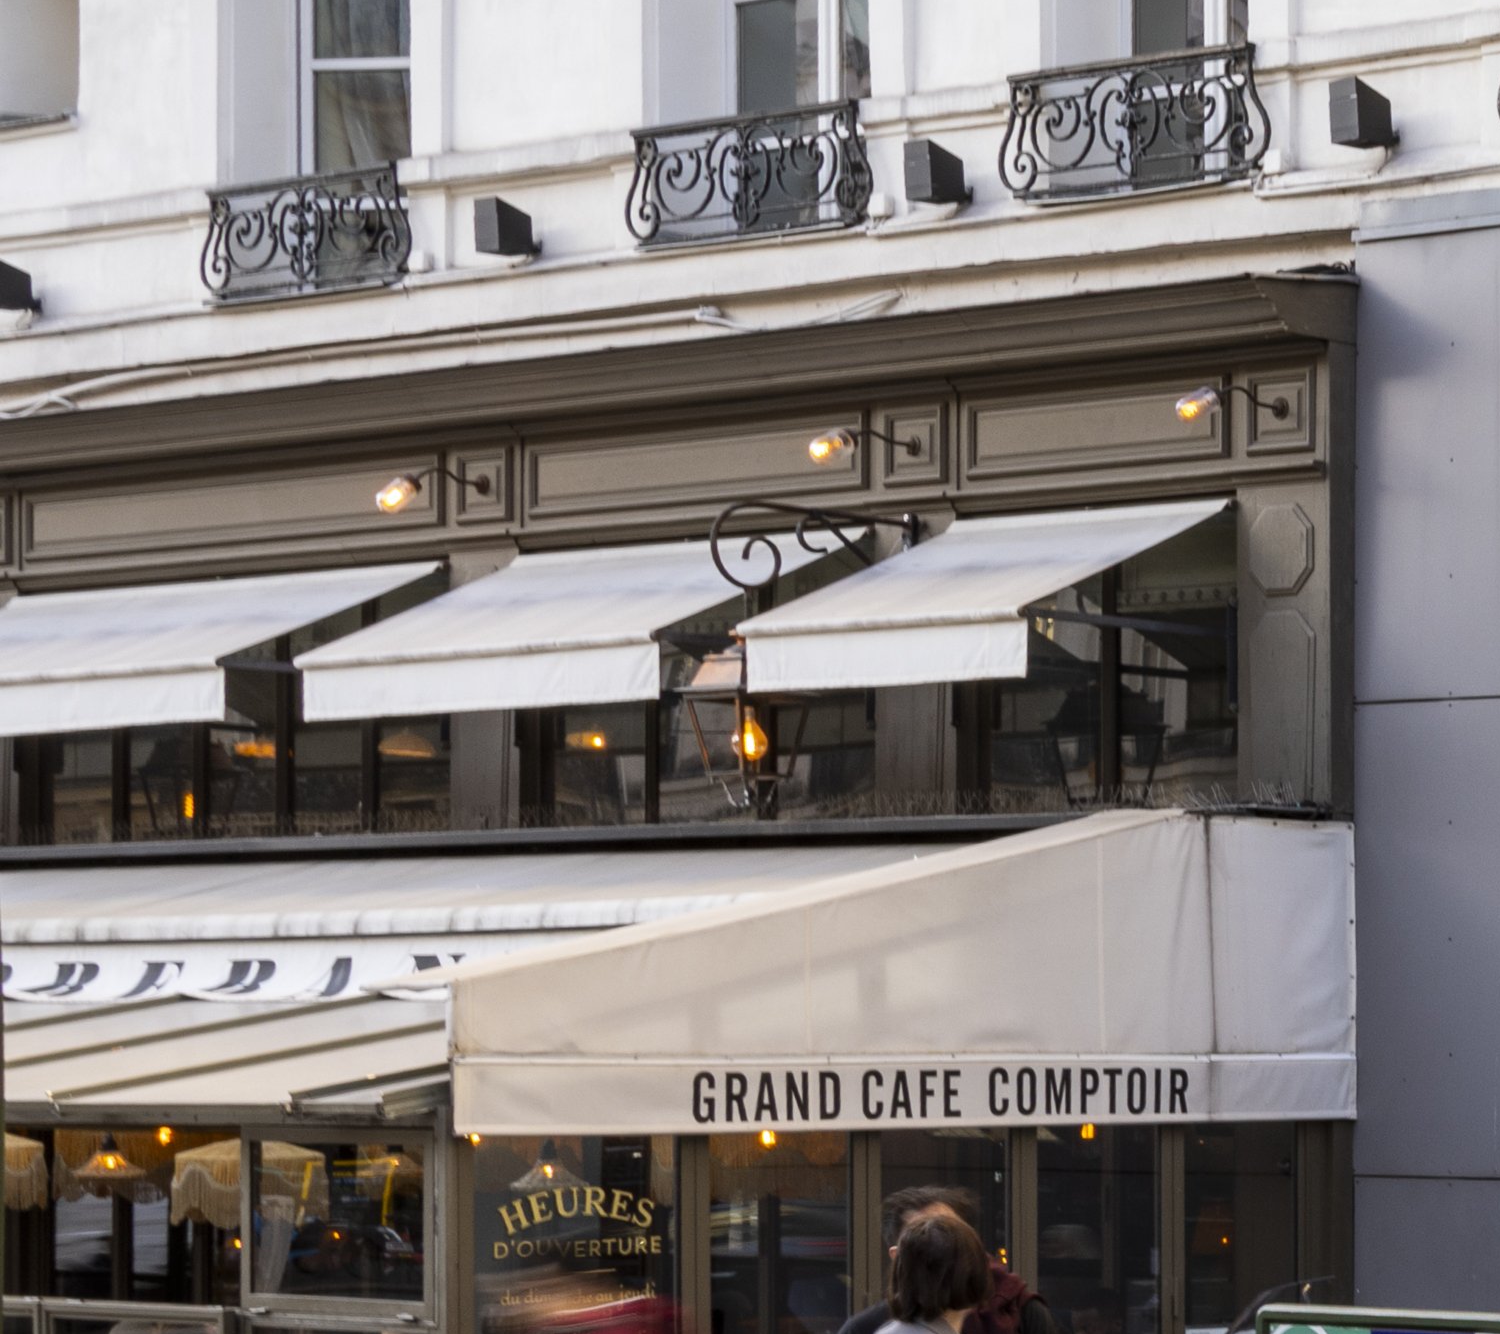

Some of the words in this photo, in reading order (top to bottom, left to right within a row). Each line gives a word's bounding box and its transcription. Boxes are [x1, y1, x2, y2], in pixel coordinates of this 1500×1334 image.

[692, 1070, 842, 1124] GRAND
[861, 1068, 963, 1120] CAFE
[987, 1066, 1190, 1117] COMPTOIR
[497, 1185, 656, 1237] HEURES
[492, 1235, 662, 1260] D'OUVERTURE
